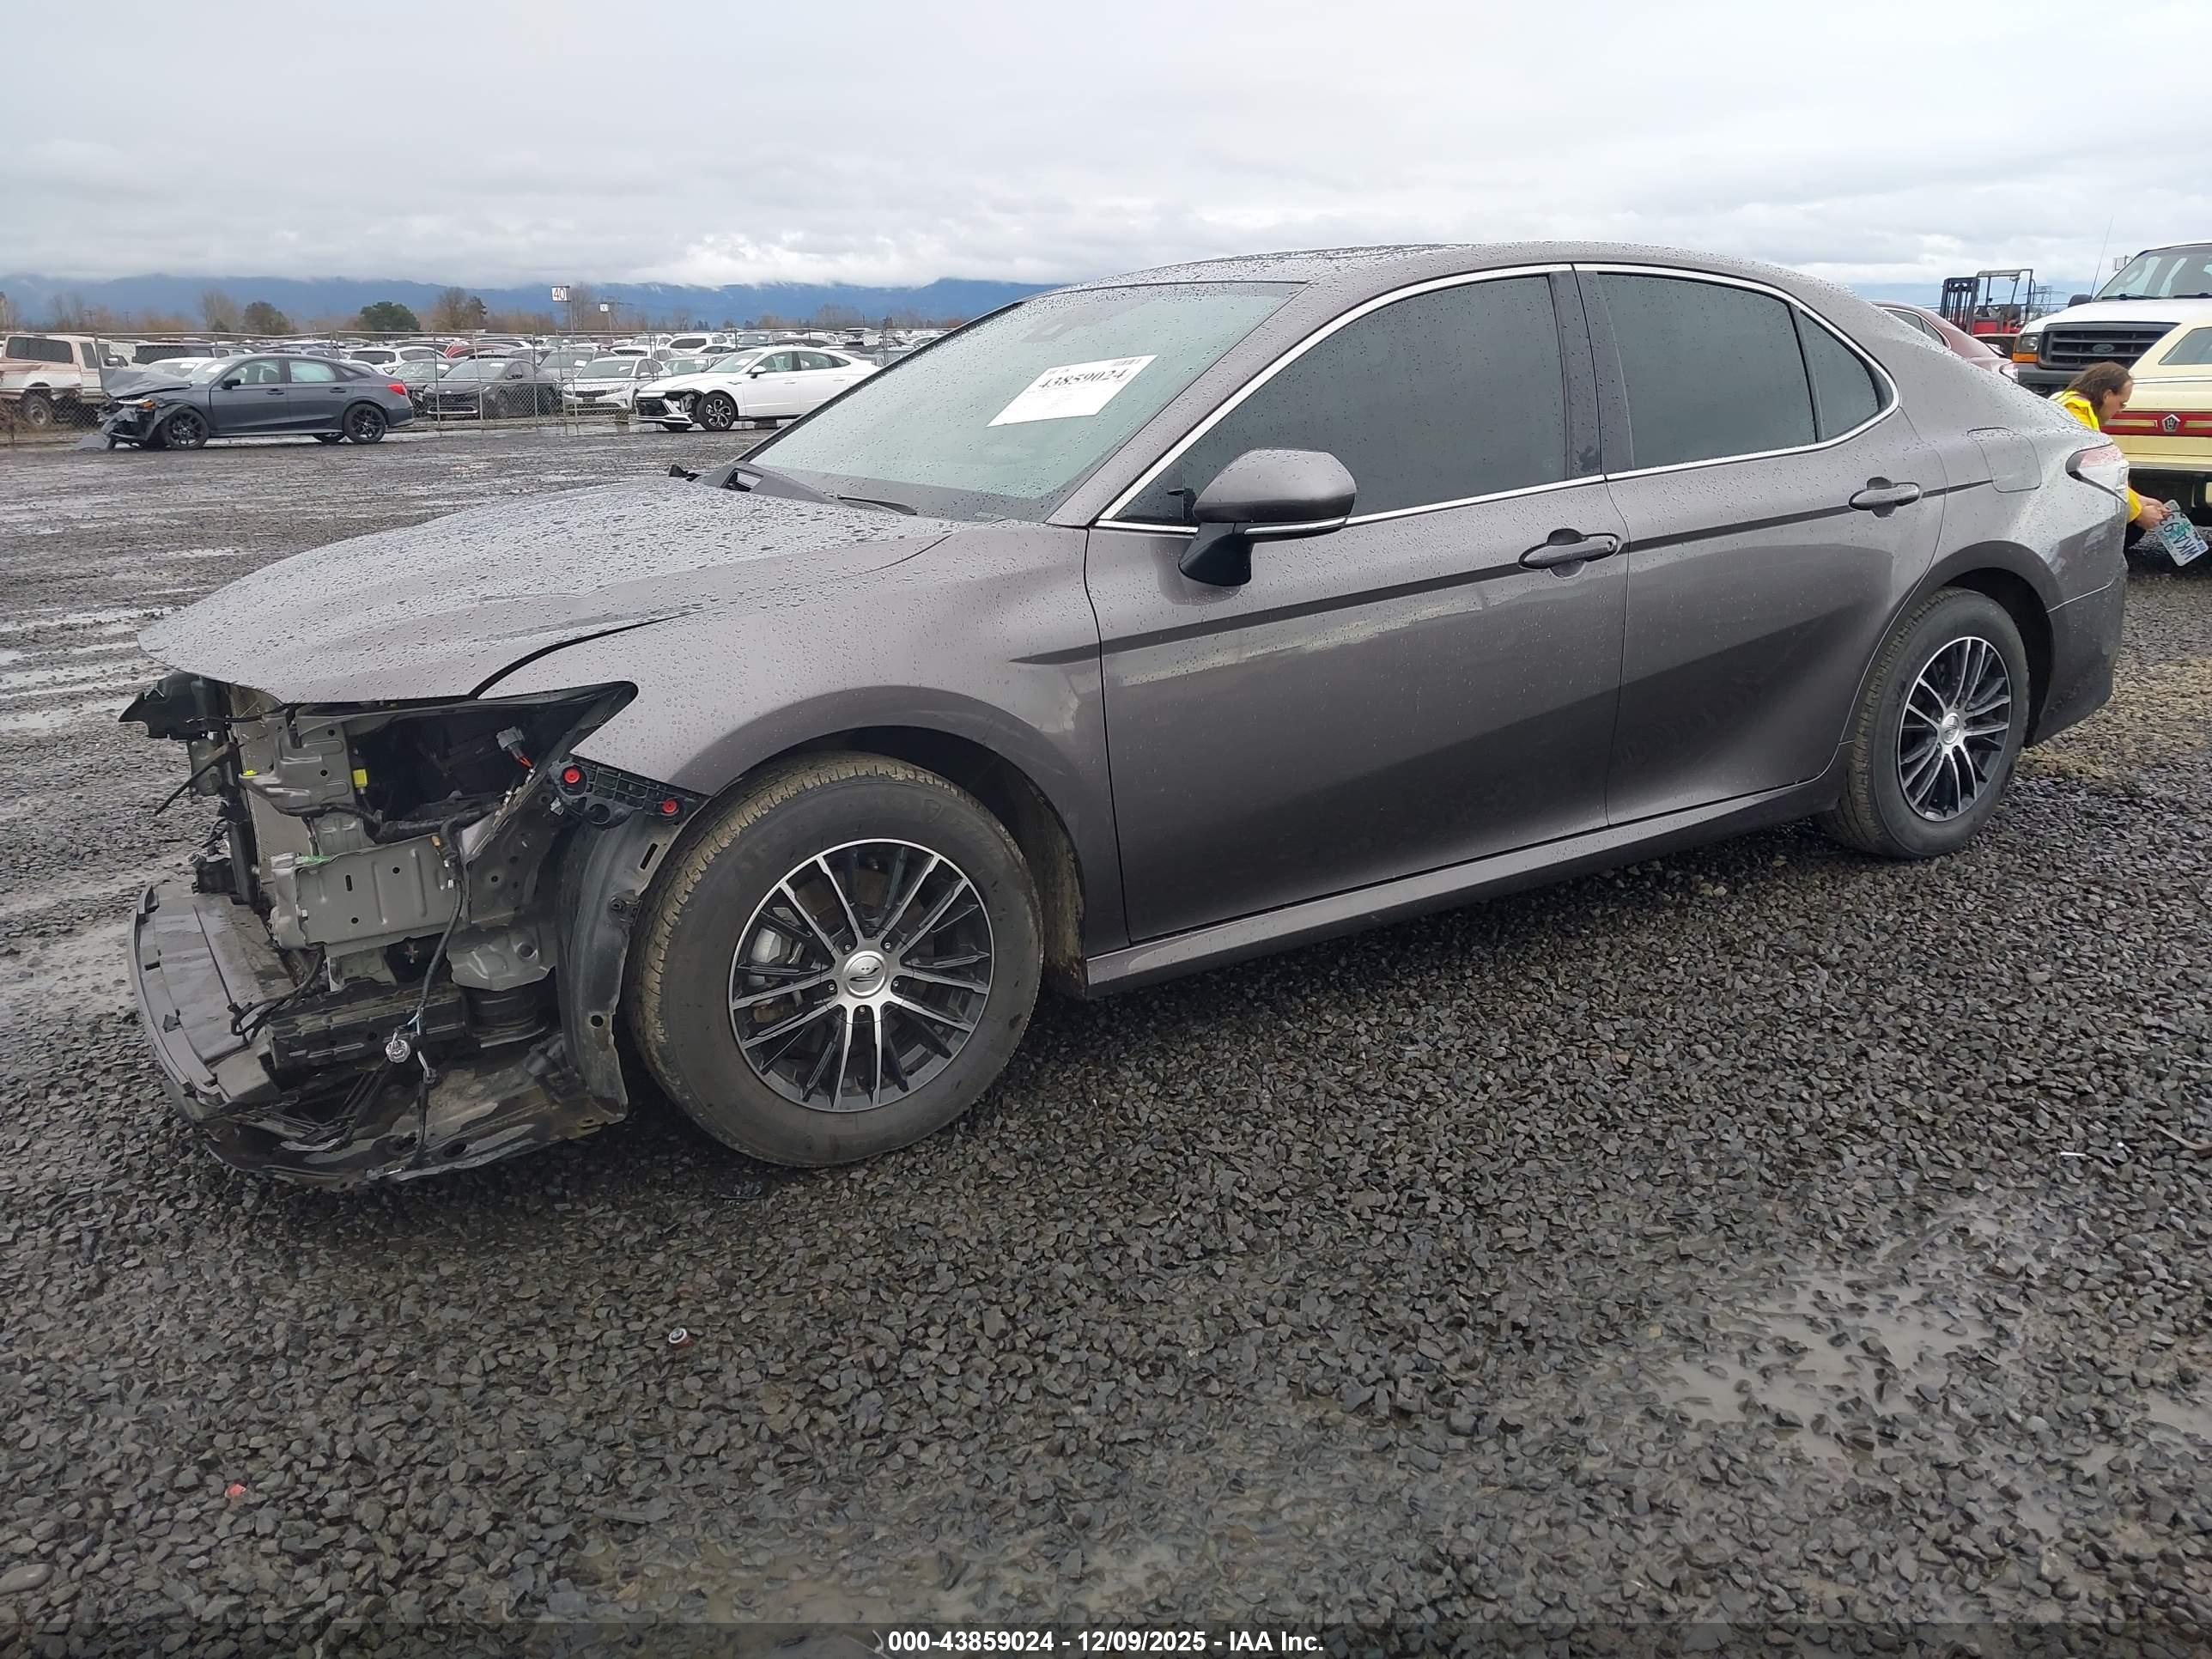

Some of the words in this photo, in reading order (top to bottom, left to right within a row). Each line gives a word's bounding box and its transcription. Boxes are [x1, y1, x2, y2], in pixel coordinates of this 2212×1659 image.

[553, 288, 566, 301] 40
[1038, 368, 1129, 389] 43859024
[2172, 532, 2201, 561] WKA
